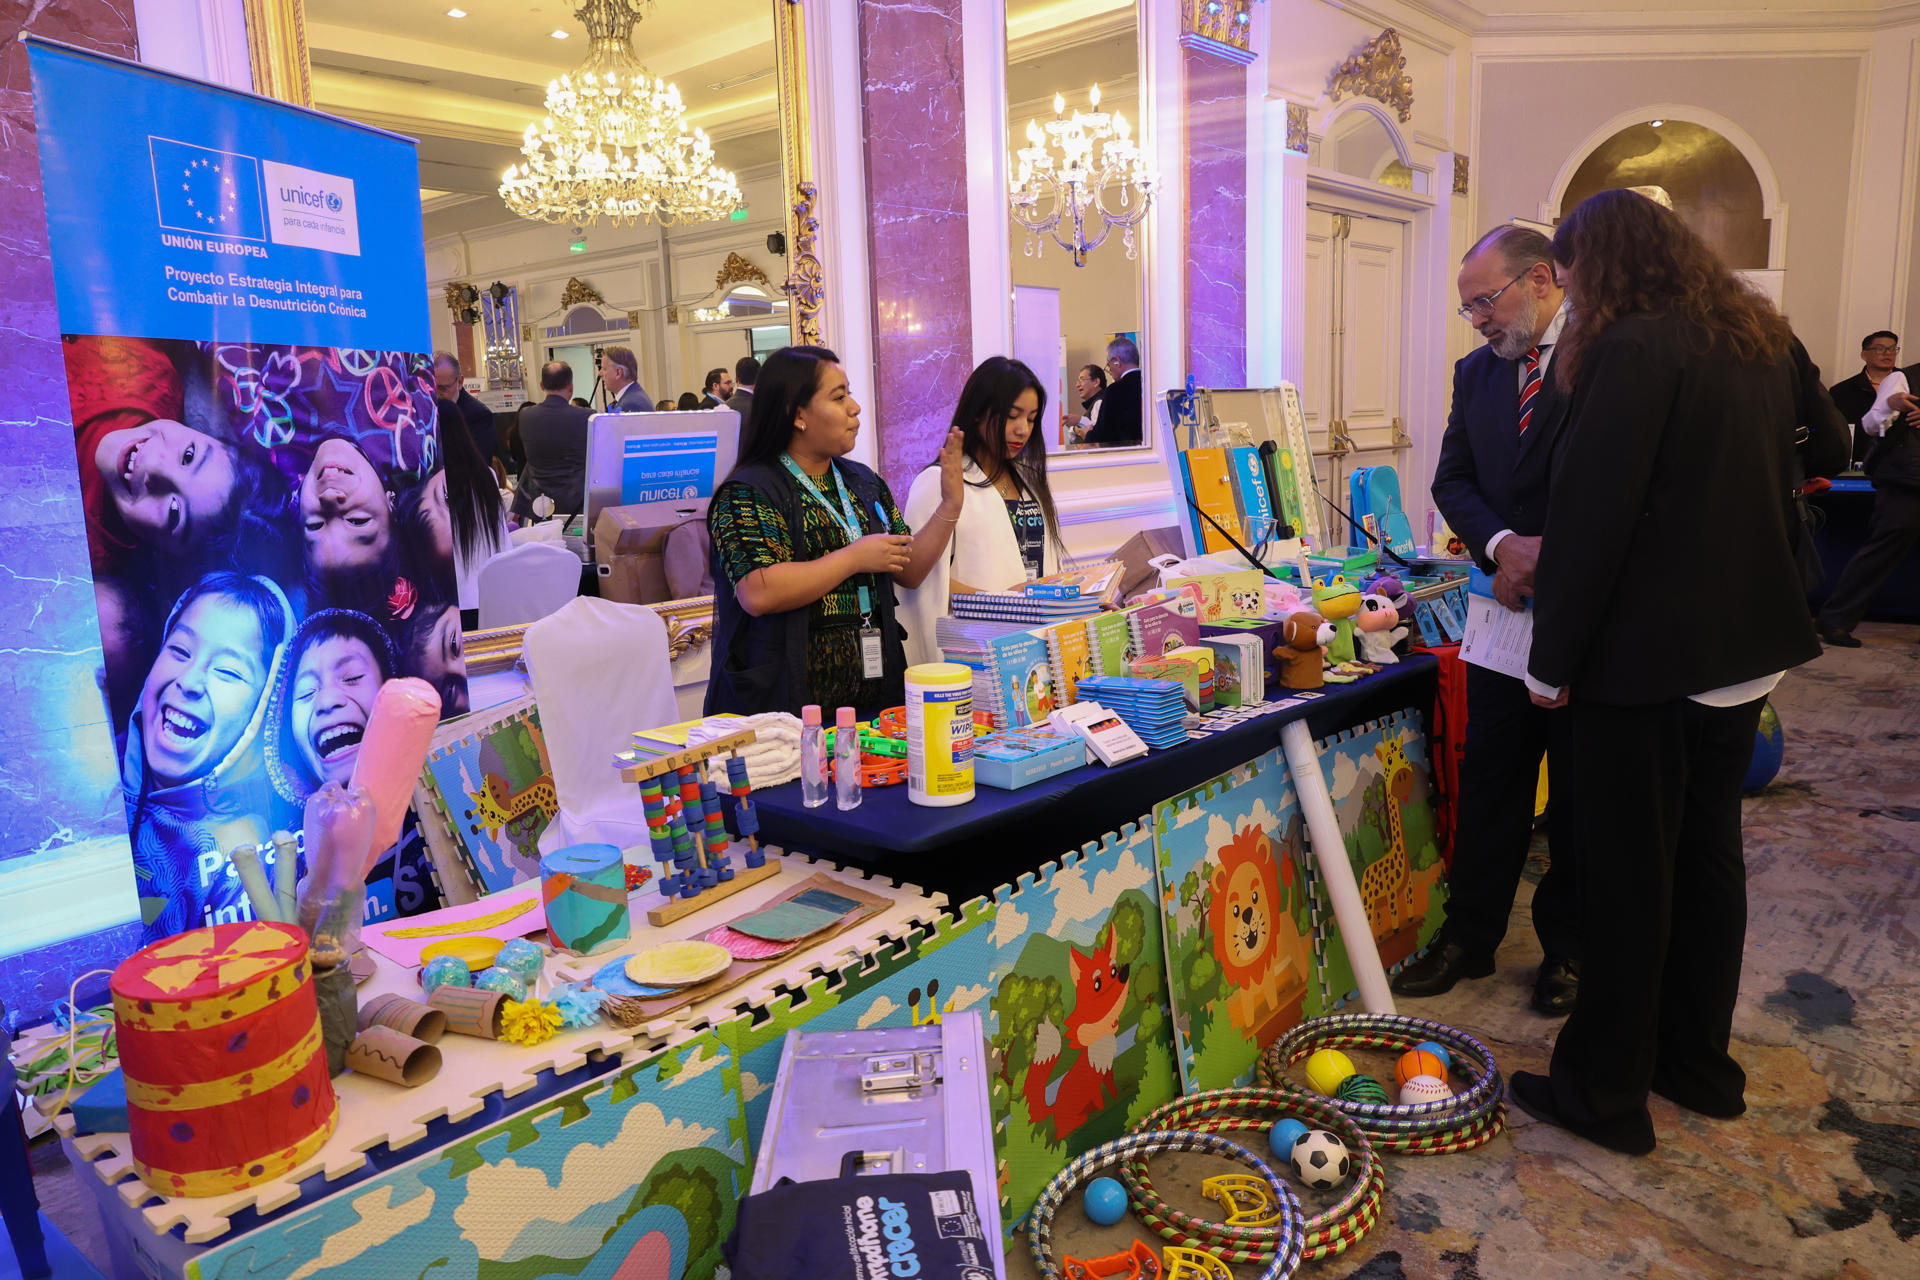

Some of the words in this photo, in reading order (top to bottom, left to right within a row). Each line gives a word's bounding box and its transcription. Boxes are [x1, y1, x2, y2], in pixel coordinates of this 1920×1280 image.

[280, 186, 324, 209] unicef
[283, 217, 301, 227] para
[302, 220, 319, 230] cada
[320, 222, 345, 235] infancia
[161, 233, 203, 251] UNIÓN
[206, 240, 269, 259] EUROPEA
[164, 265, 225, 287] Proyecto
[228, 272, 293, 294] Estrategia
[296, 280, 338, 298] Integral
[340, 286, 363, 300] para
[167, 287, 229, 306] Combatir
[233, 294, 246, 307] la
[249, 293, 327, 314] Desnutrición
[328, 301, 367, 319] Crónica
[878, 1196, 921, 1278] crecer
